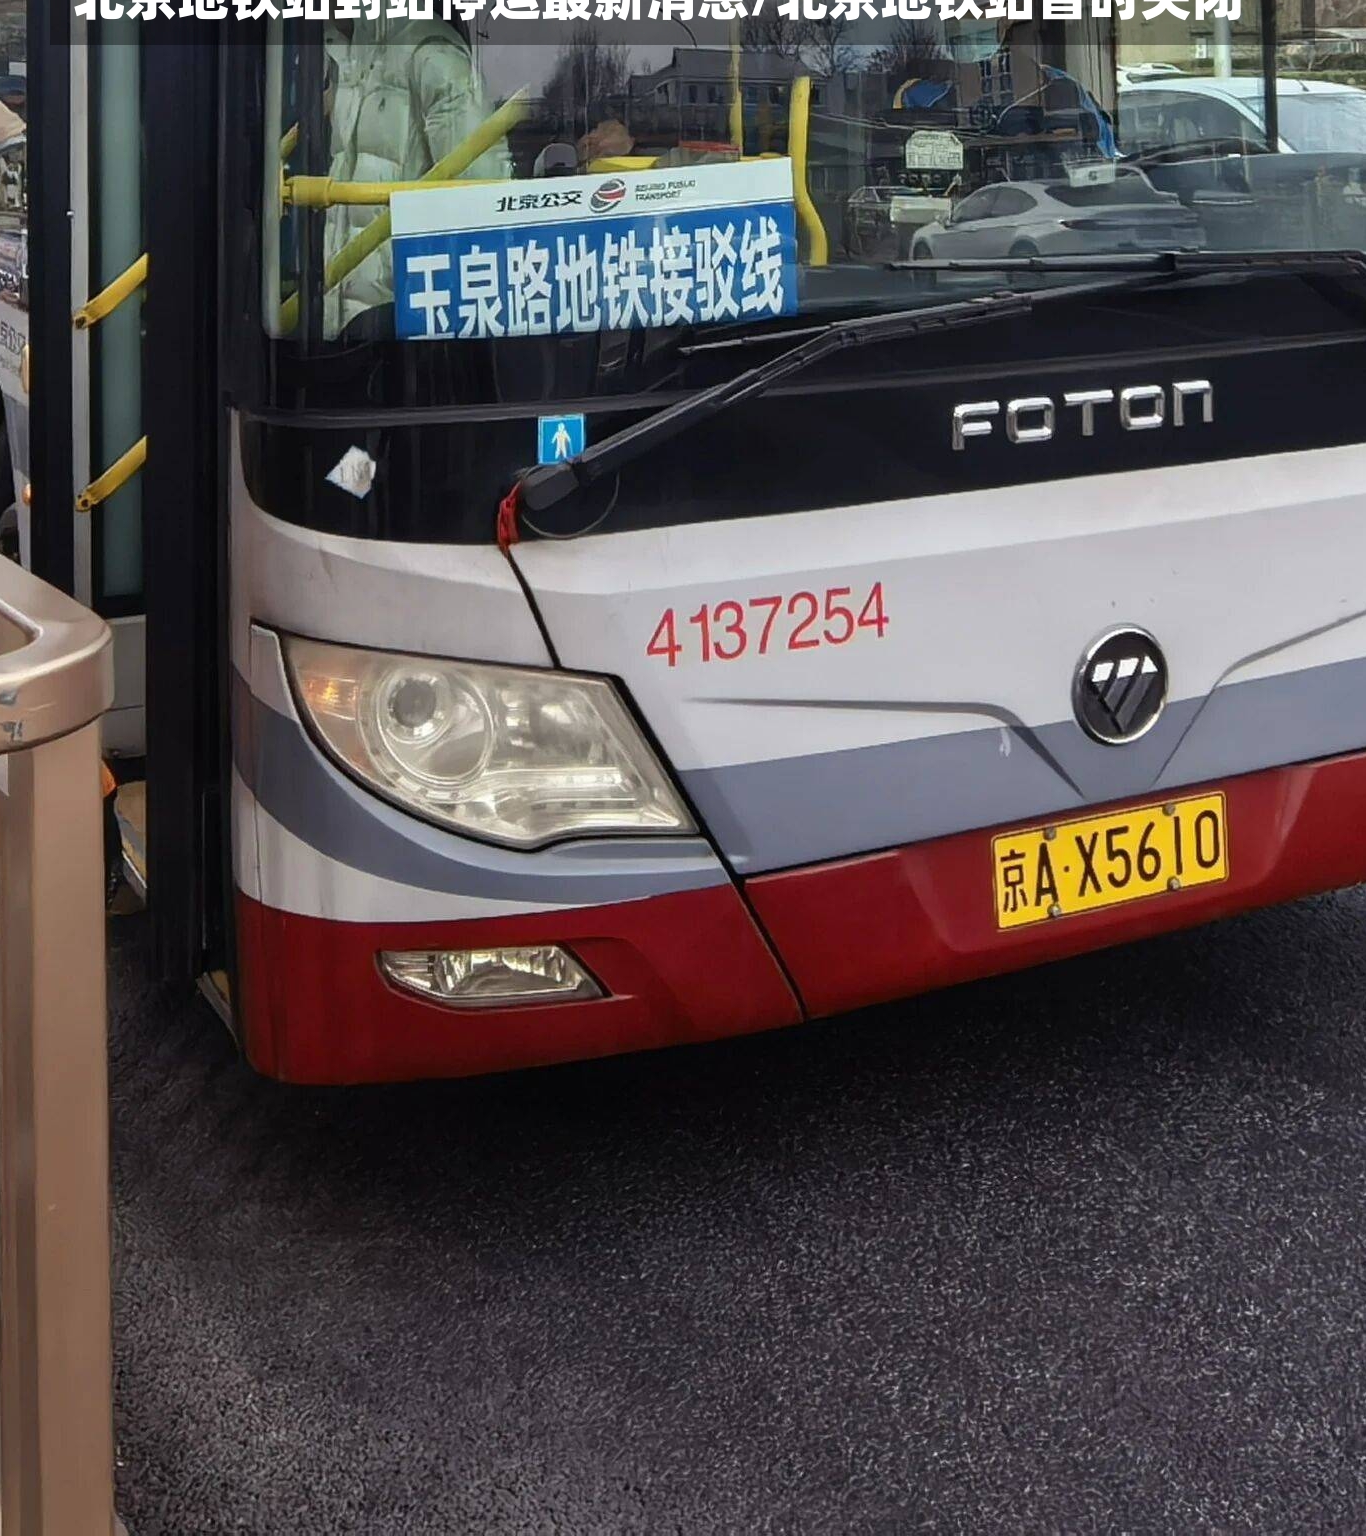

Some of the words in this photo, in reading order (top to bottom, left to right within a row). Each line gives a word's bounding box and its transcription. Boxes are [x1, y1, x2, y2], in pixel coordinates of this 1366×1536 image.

[496, 190, 583, 212] 北京公交
[407, 216, 785, 339] 玉泉路地铁接驳线
[952, 379, 1213, 451] FOTON
[647, 581, 890, 668] 4137254
